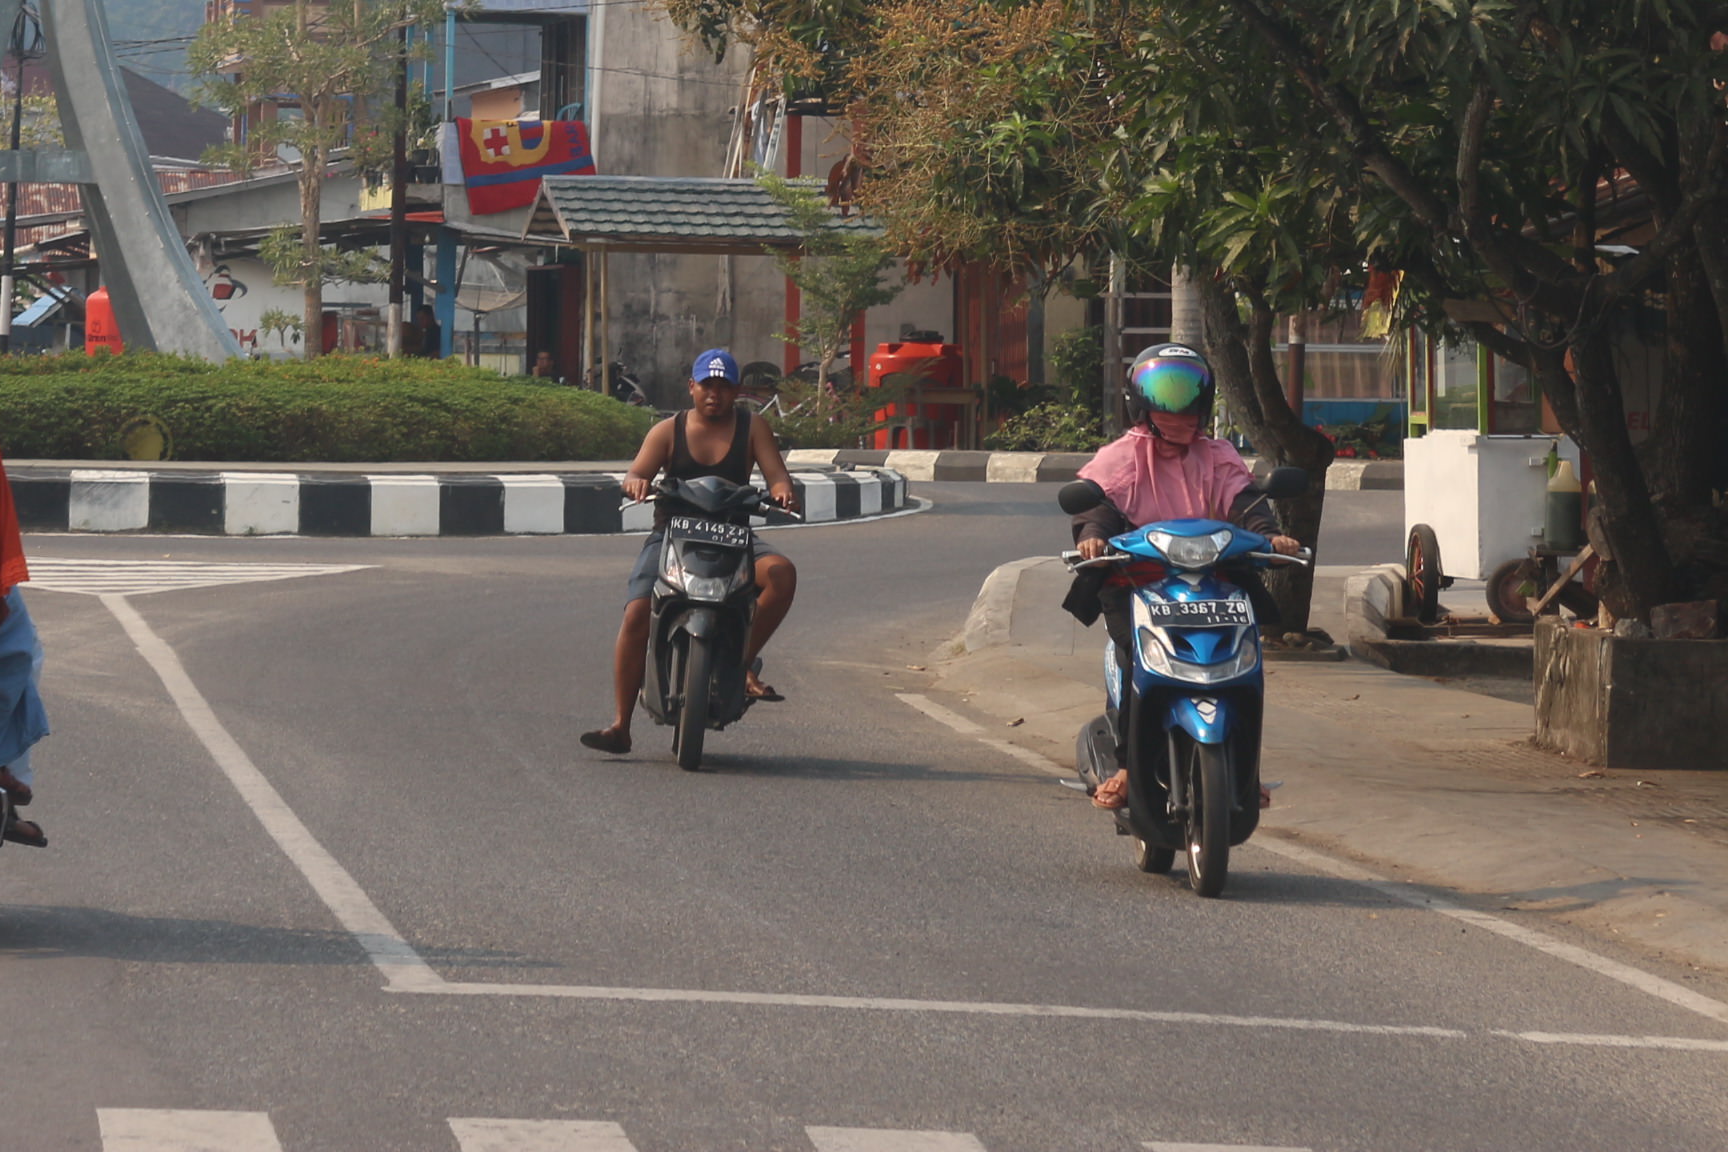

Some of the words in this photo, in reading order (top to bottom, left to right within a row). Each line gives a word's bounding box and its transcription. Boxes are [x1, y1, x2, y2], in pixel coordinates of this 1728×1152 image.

[673, 518, 689, 529] KB
[695, 521, 724, 534] 4145
[1151, 605, 1171, 616] KB
[1179, 602, 1217, 614] 3367
